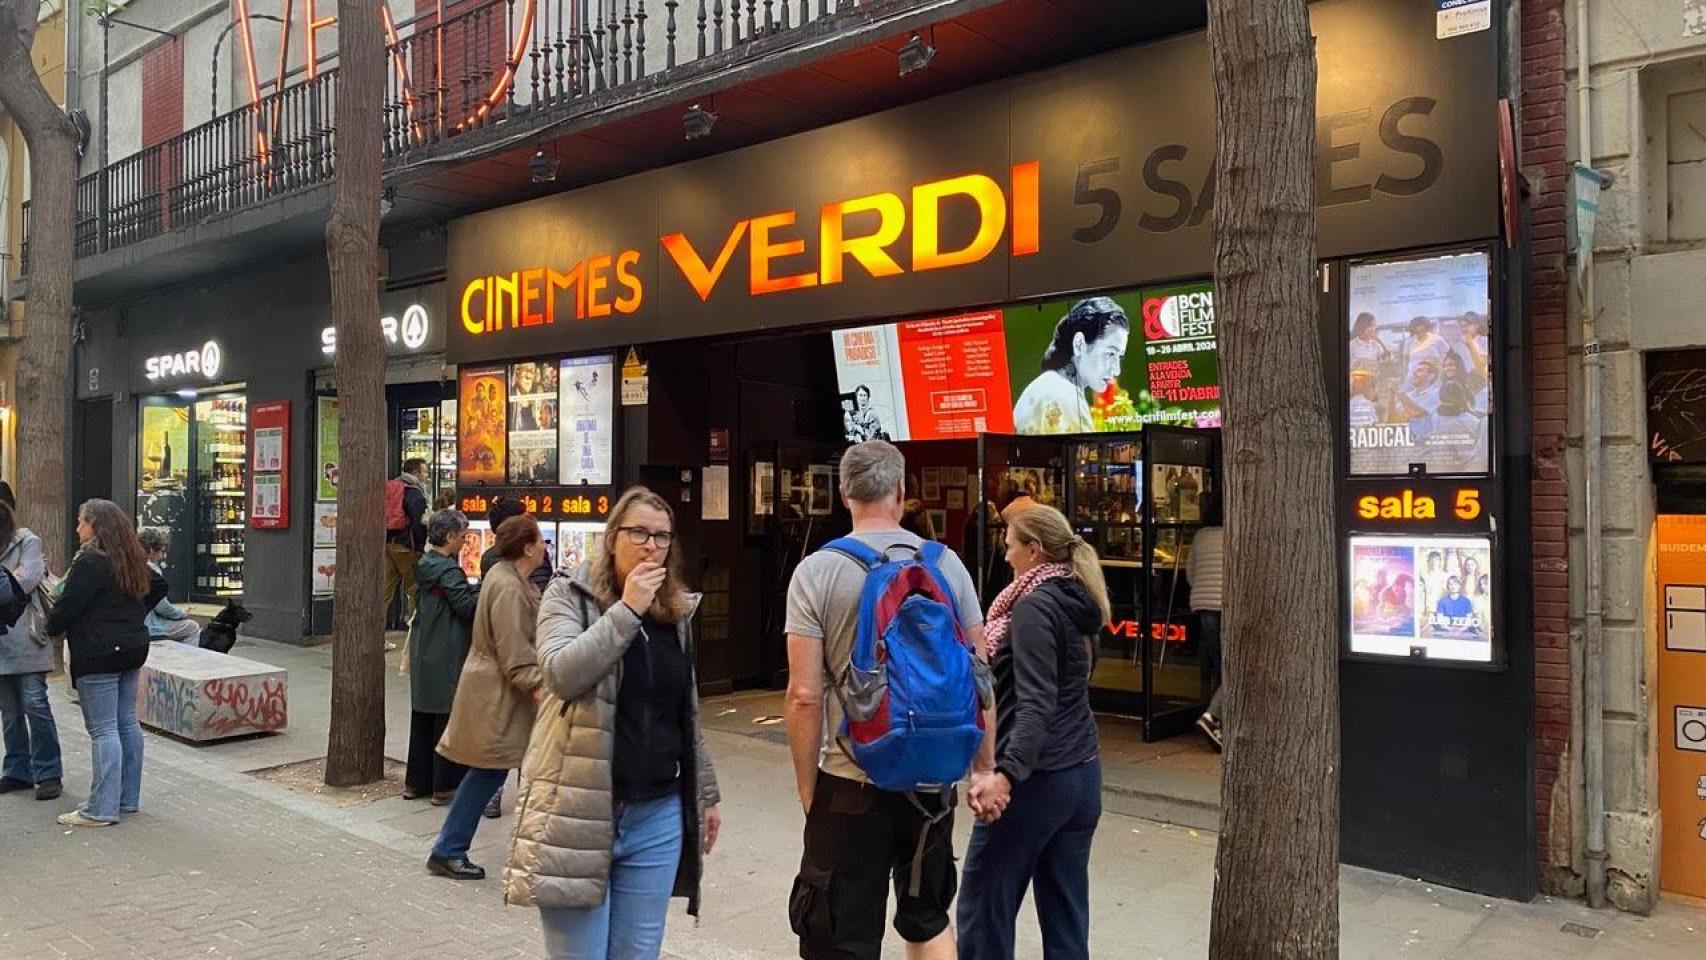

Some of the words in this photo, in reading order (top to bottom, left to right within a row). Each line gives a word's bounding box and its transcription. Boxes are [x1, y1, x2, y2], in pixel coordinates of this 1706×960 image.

[461, 249, 641, 334] CINEMES
[660, 160, 1039, 302] VERDI
[1072, 156, 1122, 244] 5
[1138, 96, 1444, 233] SES
[1179, 292, 1213, 309] BCN
[1180, 307, 1215, 323] FILM
[321, 316, 398, 353] SR
[1181, 321, 1215, 337] FEST
[1196, 341, 1216, 351] 2024
[145, 350, 200, 380] SPAR
[1148, 360, 1189, 372] ENTRADES
[1152, 389, 1166, 398] DEL
[1165, 389, 1177, 401] 11
[462, 496, 487, 512] sala
[543, 496, 552, 512] 2
[562, 496, 591, 513] sala
[597, 497, 608, 513] 3
[1358, 490, 1437, 519] sala
[1455, 489, 1482, 520] 5
